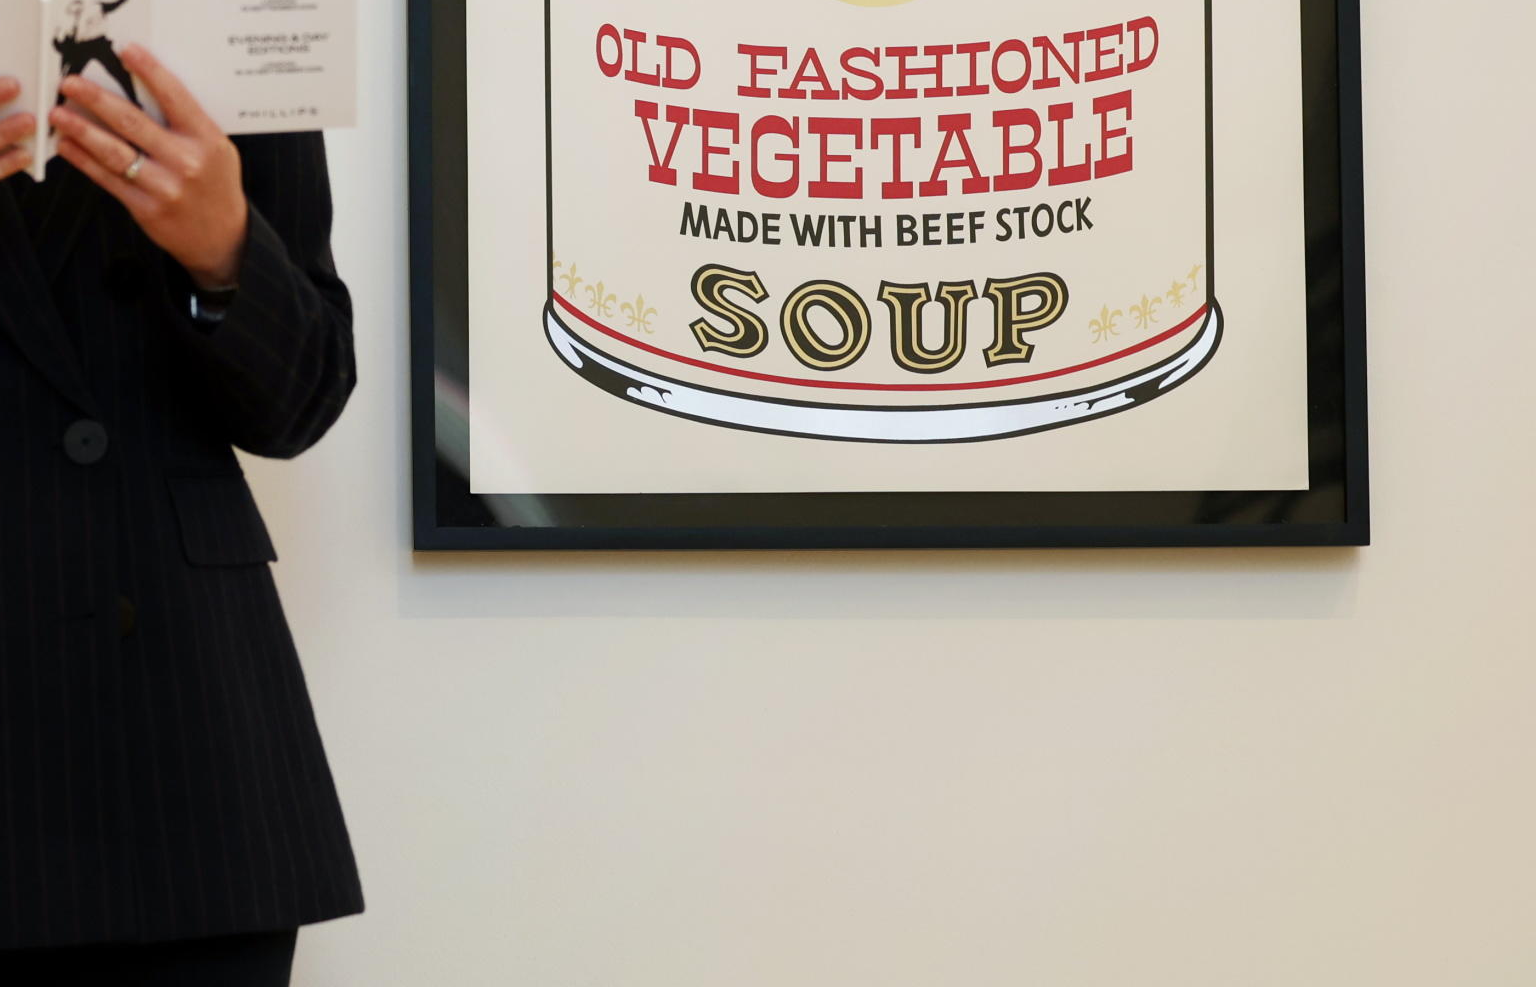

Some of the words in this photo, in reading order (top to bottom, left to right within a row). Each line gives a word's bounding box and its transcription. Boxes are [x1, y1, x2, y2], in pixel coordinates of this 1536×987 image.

[595, 22, 702, 89] OLD
[736, 15, 1160, 101] FASHIONED
[634, 89, 1134, 200] VEGETABLE
[679, 201, 782, 246] MADE
[789, 213, 883, 248] WITH
[896, 209, 986, 248] BEEF
[995, 196, 1095, 243] STOCK
[688, 263, 1070, 374] SOUP
